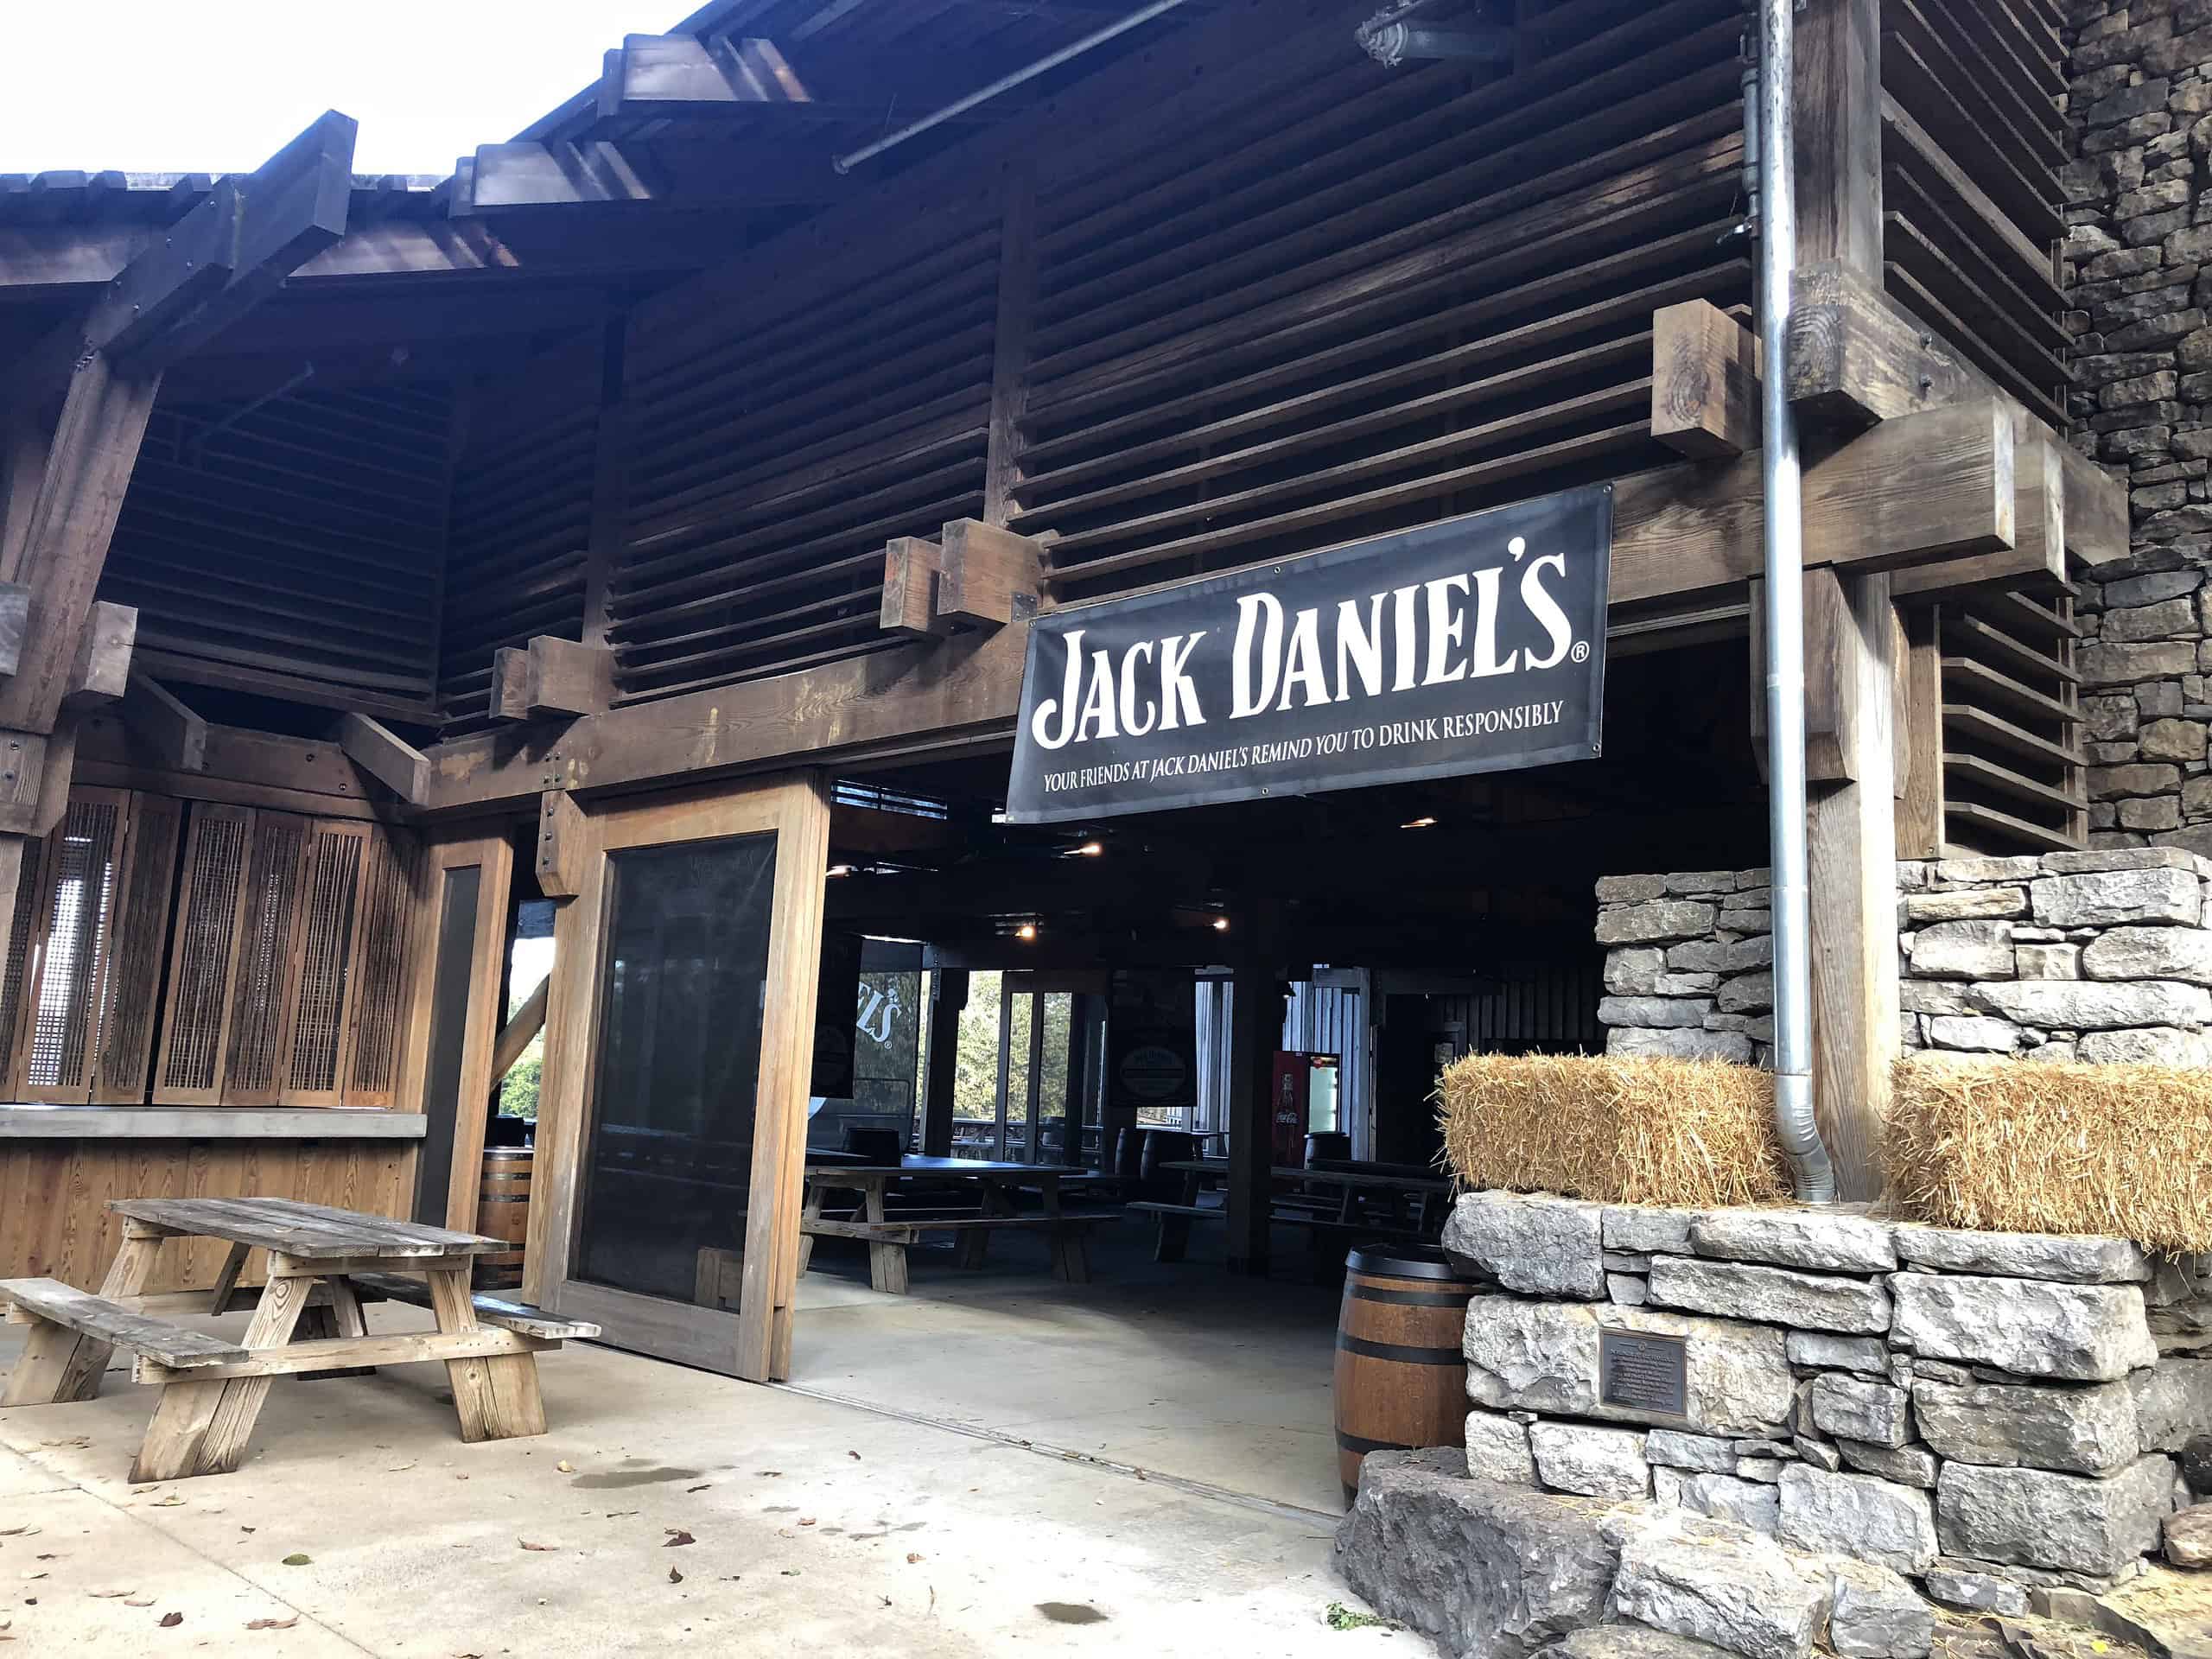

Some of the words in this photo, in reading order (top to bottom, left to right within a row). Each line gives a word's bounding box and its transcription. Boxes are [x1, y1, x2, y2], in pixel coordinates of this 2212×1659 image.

[1031, 629, 1208, 750] JACK
[1230, 537, 1574, 720] DANIEL'S
[1044, 771, 1078, 792] YOUR
[1080, 762, 1129, 788] FRIENDS
[1131, 760, 1149, 780] AT
[1149, 756, 1185, 783] JACK
[1187, 746, 1249, 775] DANIEL'S
[1251, 738, 1312, 766] REMIND
[1316, 732, 1348, 755] YOU
[1351, 727, 1375, 750] TO
[1379, 718, 1438, 747] DRINK
[1442, 700, 1564, 739] RESPONSIBLY
